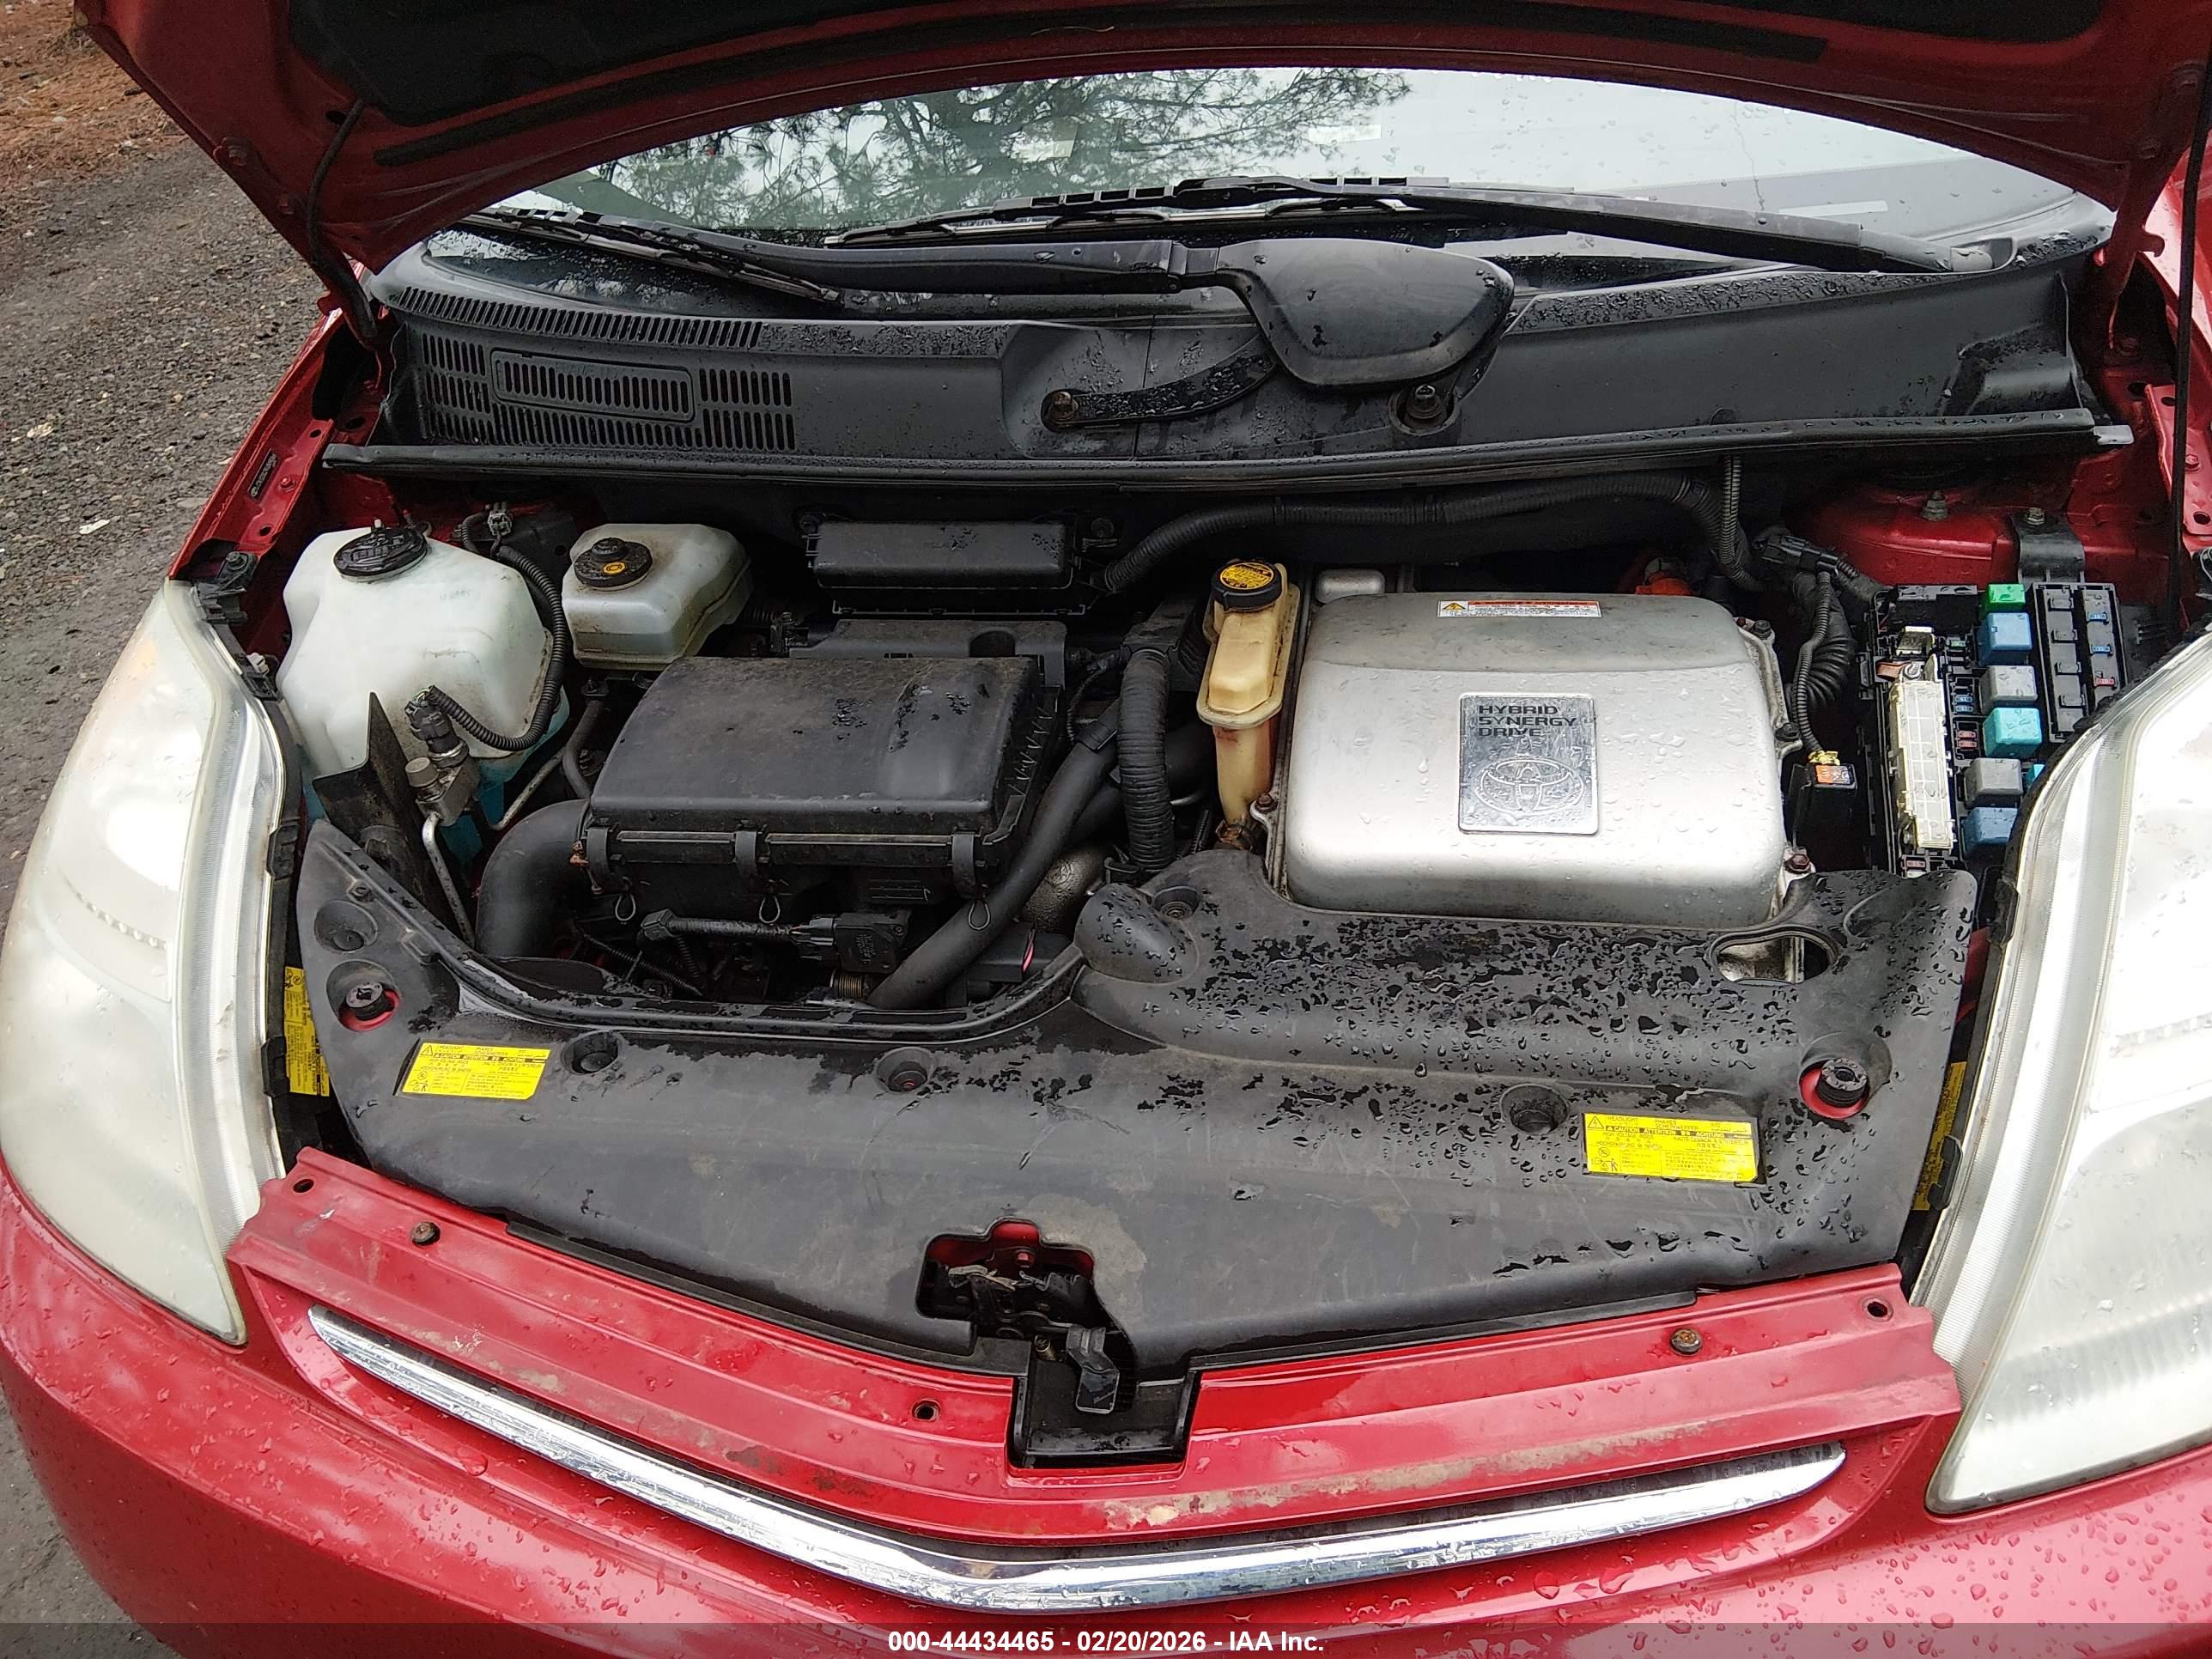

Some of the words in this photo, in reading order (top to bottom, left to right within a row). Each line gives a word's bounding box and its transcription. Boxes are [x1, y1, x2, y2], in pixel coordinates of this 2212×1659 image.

[1479, 705, 1559, 714] HYBRID
[1479, 716, 1577, 726] SYNERGY
[1479, 727, 1542, 737] DRIVE
